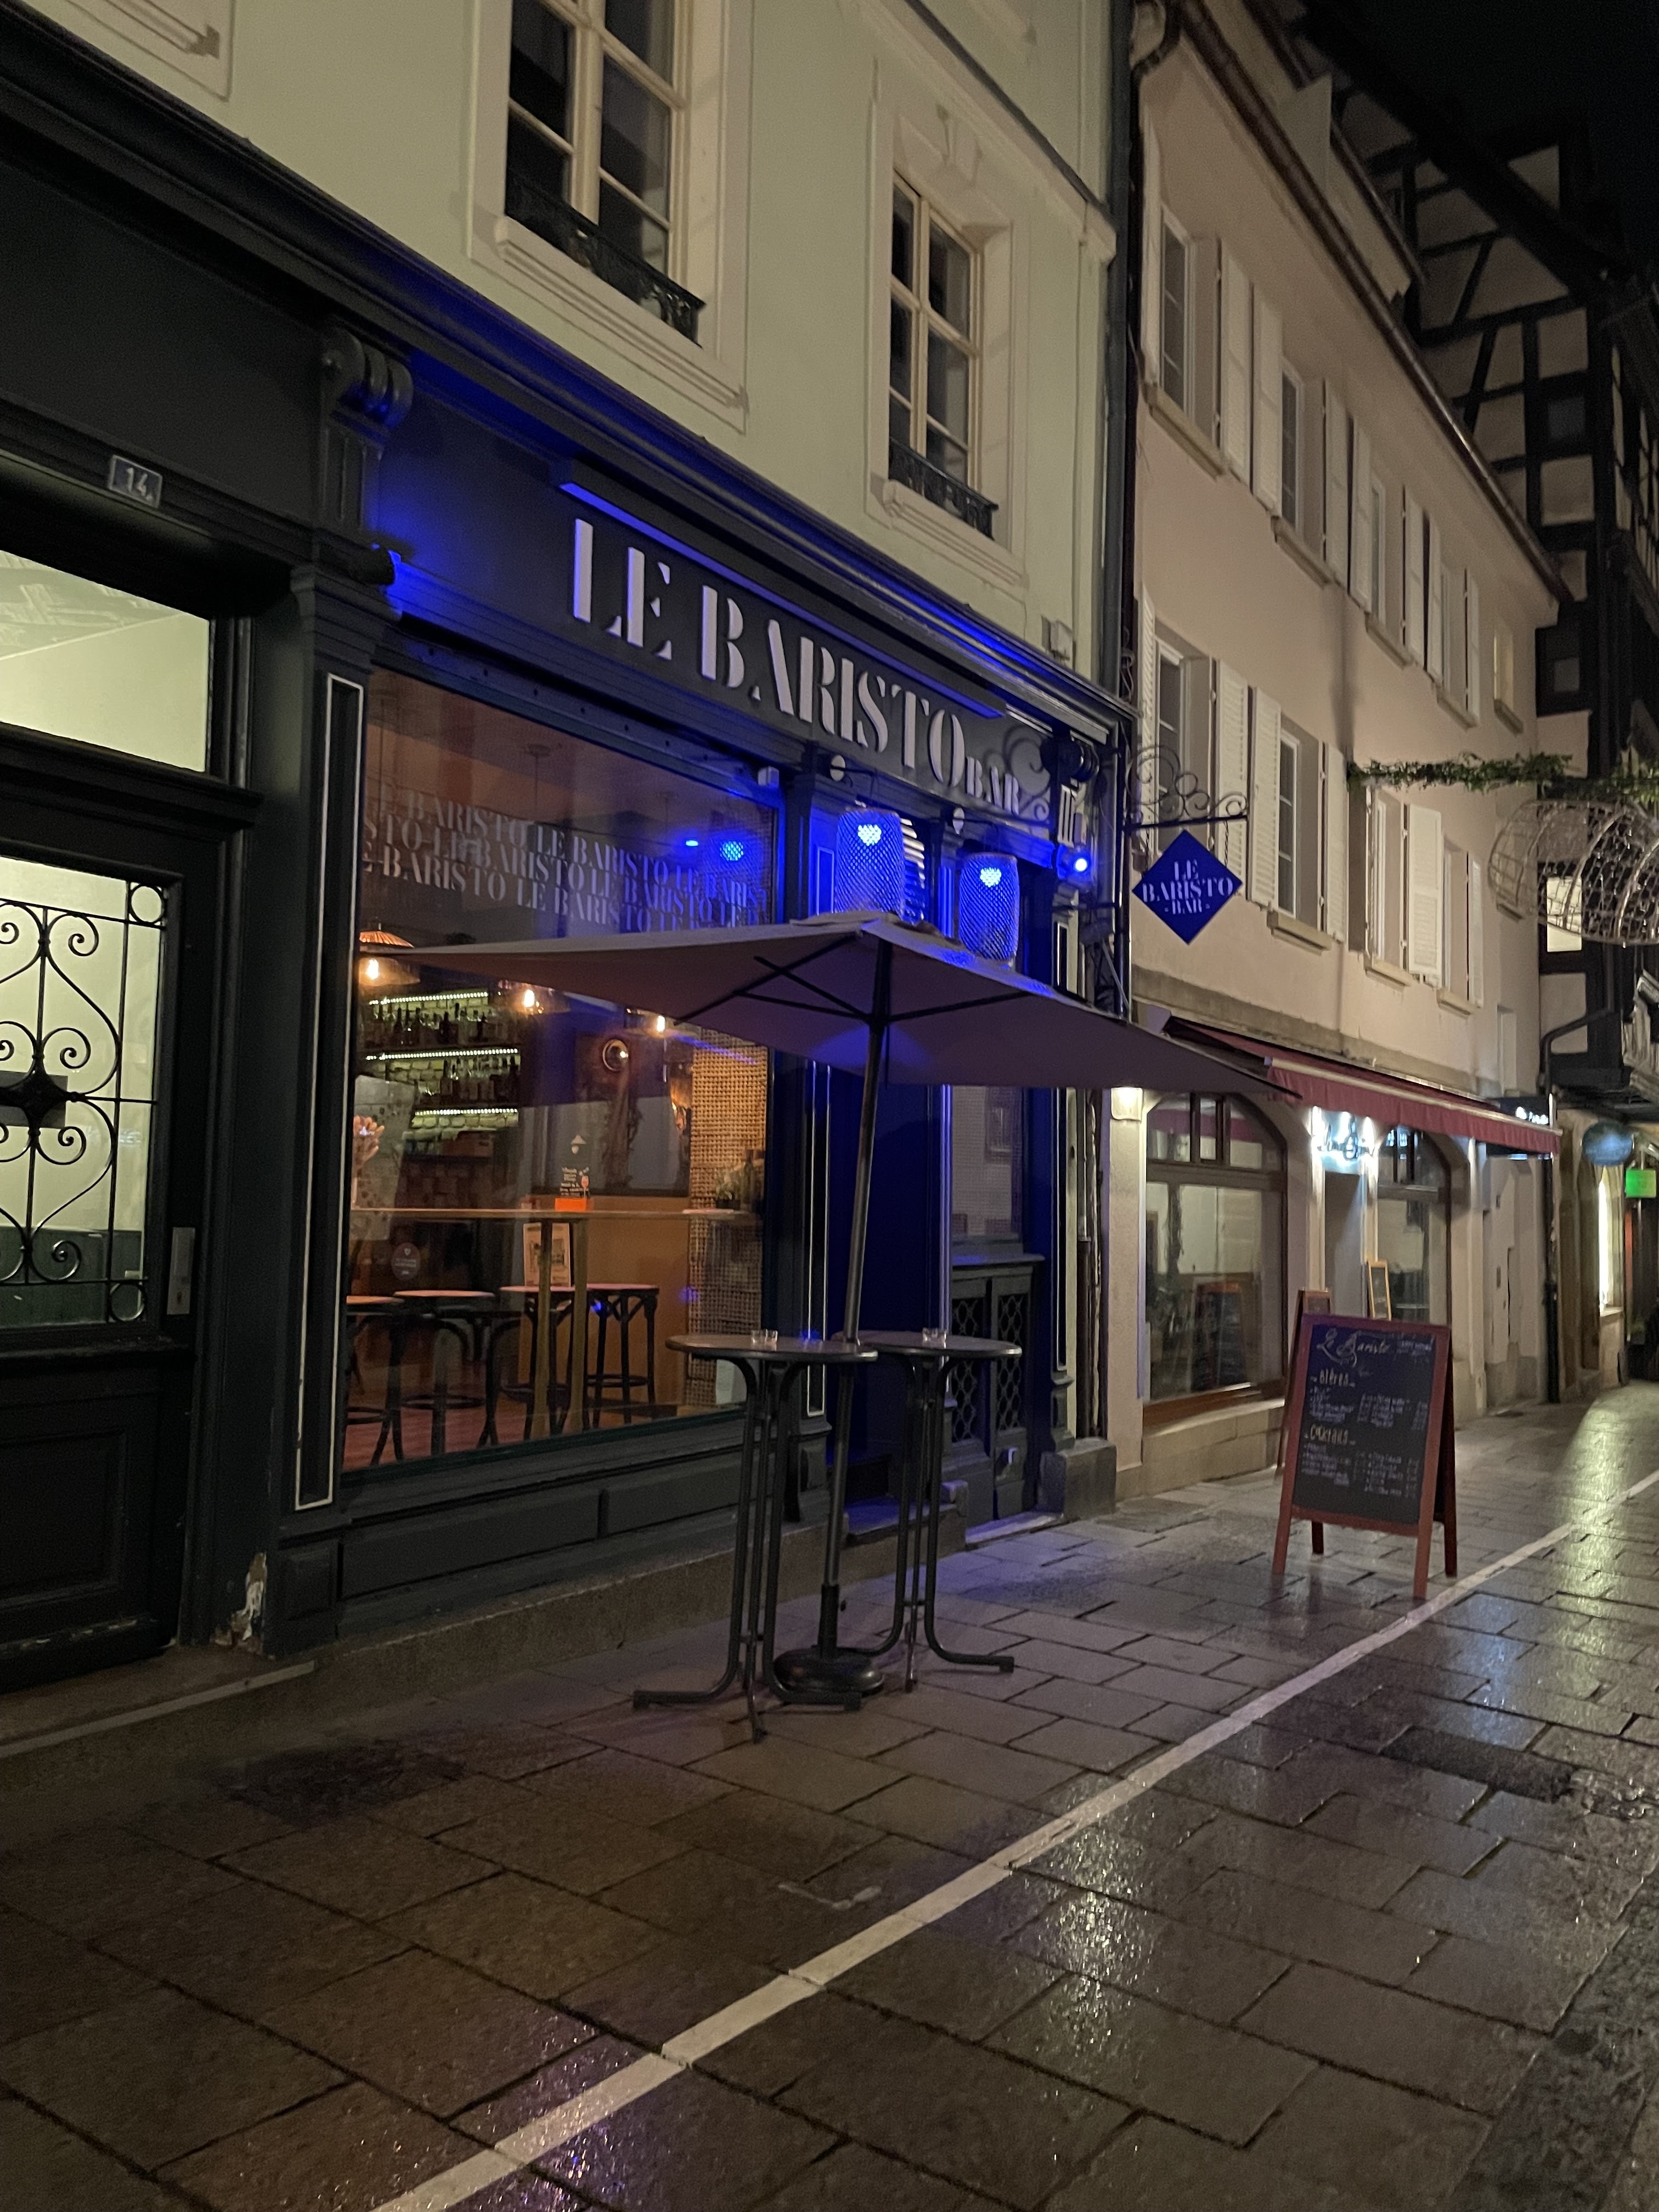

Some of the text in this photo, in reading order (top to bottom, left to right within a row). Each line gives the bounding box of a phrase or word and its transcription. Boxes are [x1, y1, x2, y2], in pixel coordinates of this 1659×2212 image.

[574, 518, 1020, 816] LE BARISTO BAR
[407, 790, 527, 847] BARISTO
[537, 825, 566, 859] LE
[573, 836, 669, 885] BARISTO
[675, 865, 700, 895] LE
[475, 838, 585, 890] BARISTO
[592, 868, 617, 900] LE
[625, 877, 712, 923] BARISTO
[1174, 859, 1199, 881] LE
[383, 845, 506, 901] BARISTO
[517, 878, 546, 911] LE
[555, 887, 652, 933] BARISTO
[1142, 877, 1233, 903] BARISTO
